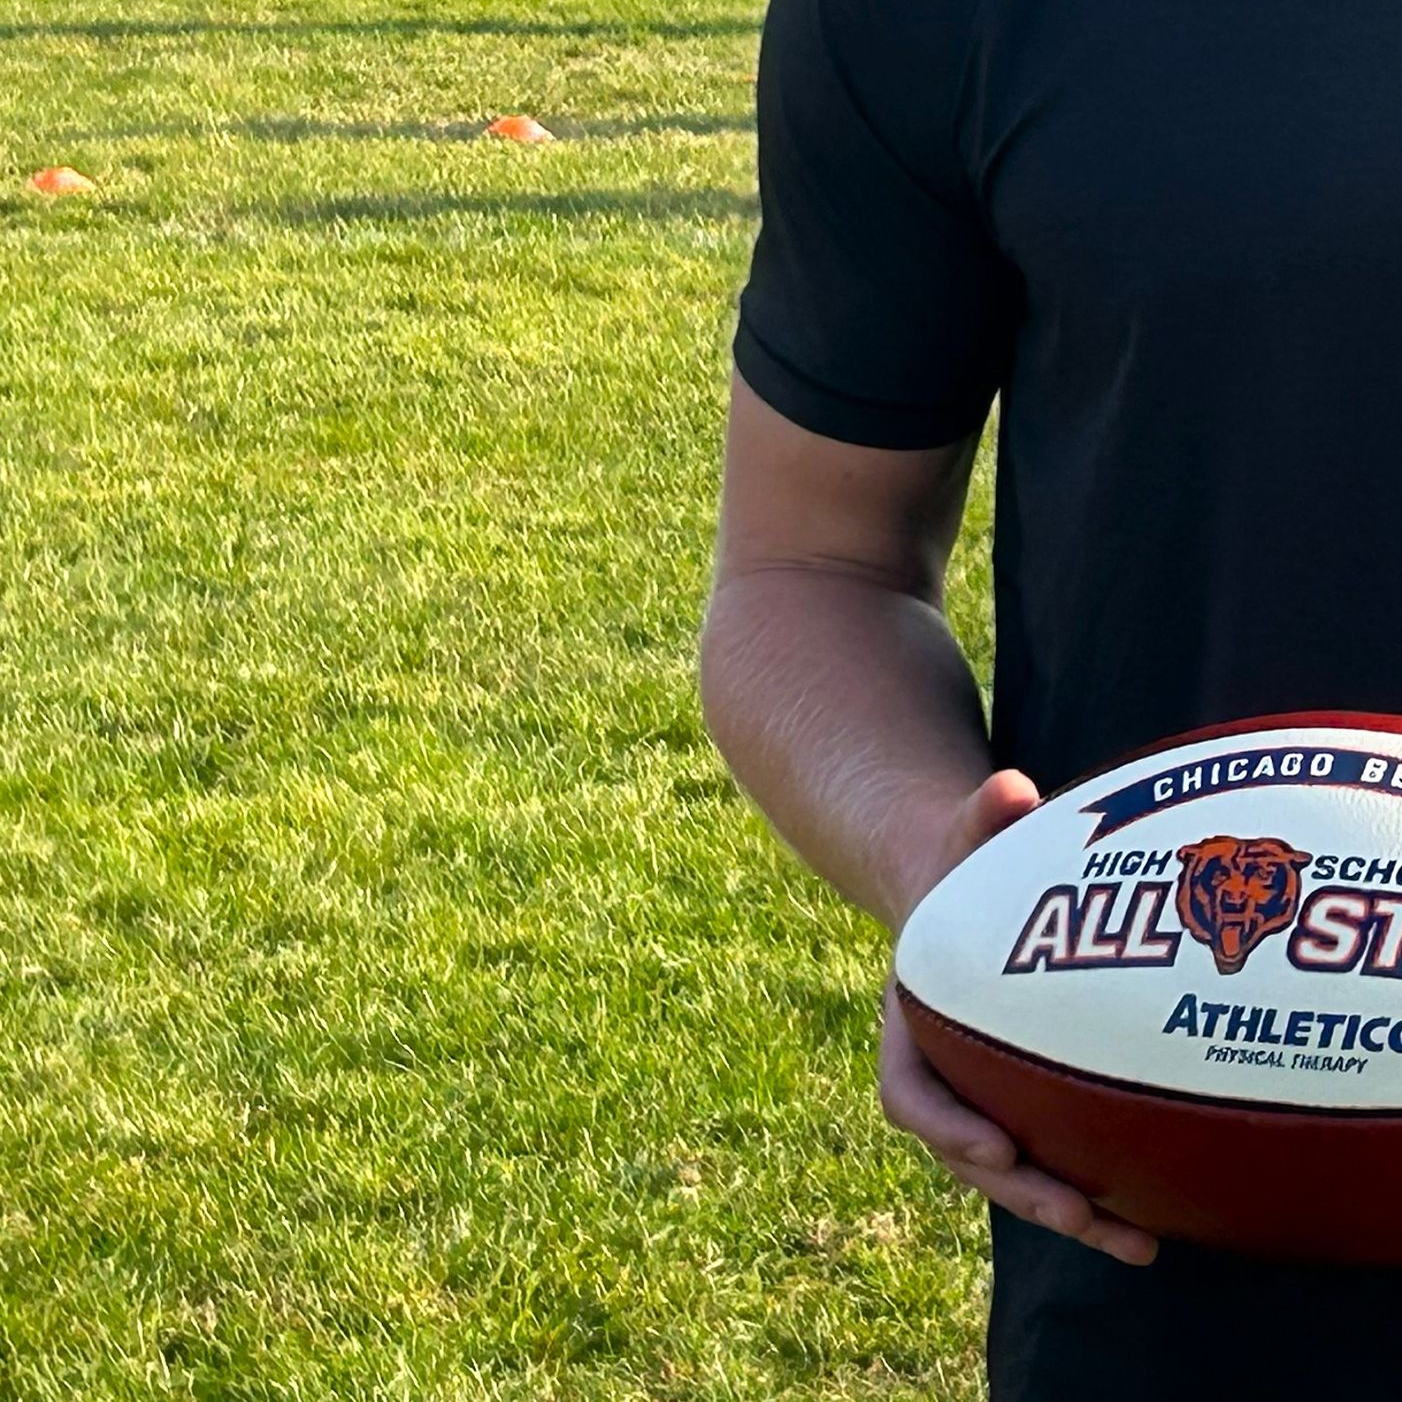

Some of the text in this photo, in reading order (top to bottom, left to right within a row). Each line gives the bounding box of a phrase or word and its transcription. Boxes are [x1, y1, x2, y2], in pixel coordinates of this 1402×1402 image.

[1152, 752, 1335, 803] CHICAGO
[1080, 848, 1174, 881] HIGH
[1001, 882, 1184, 976] ALL
